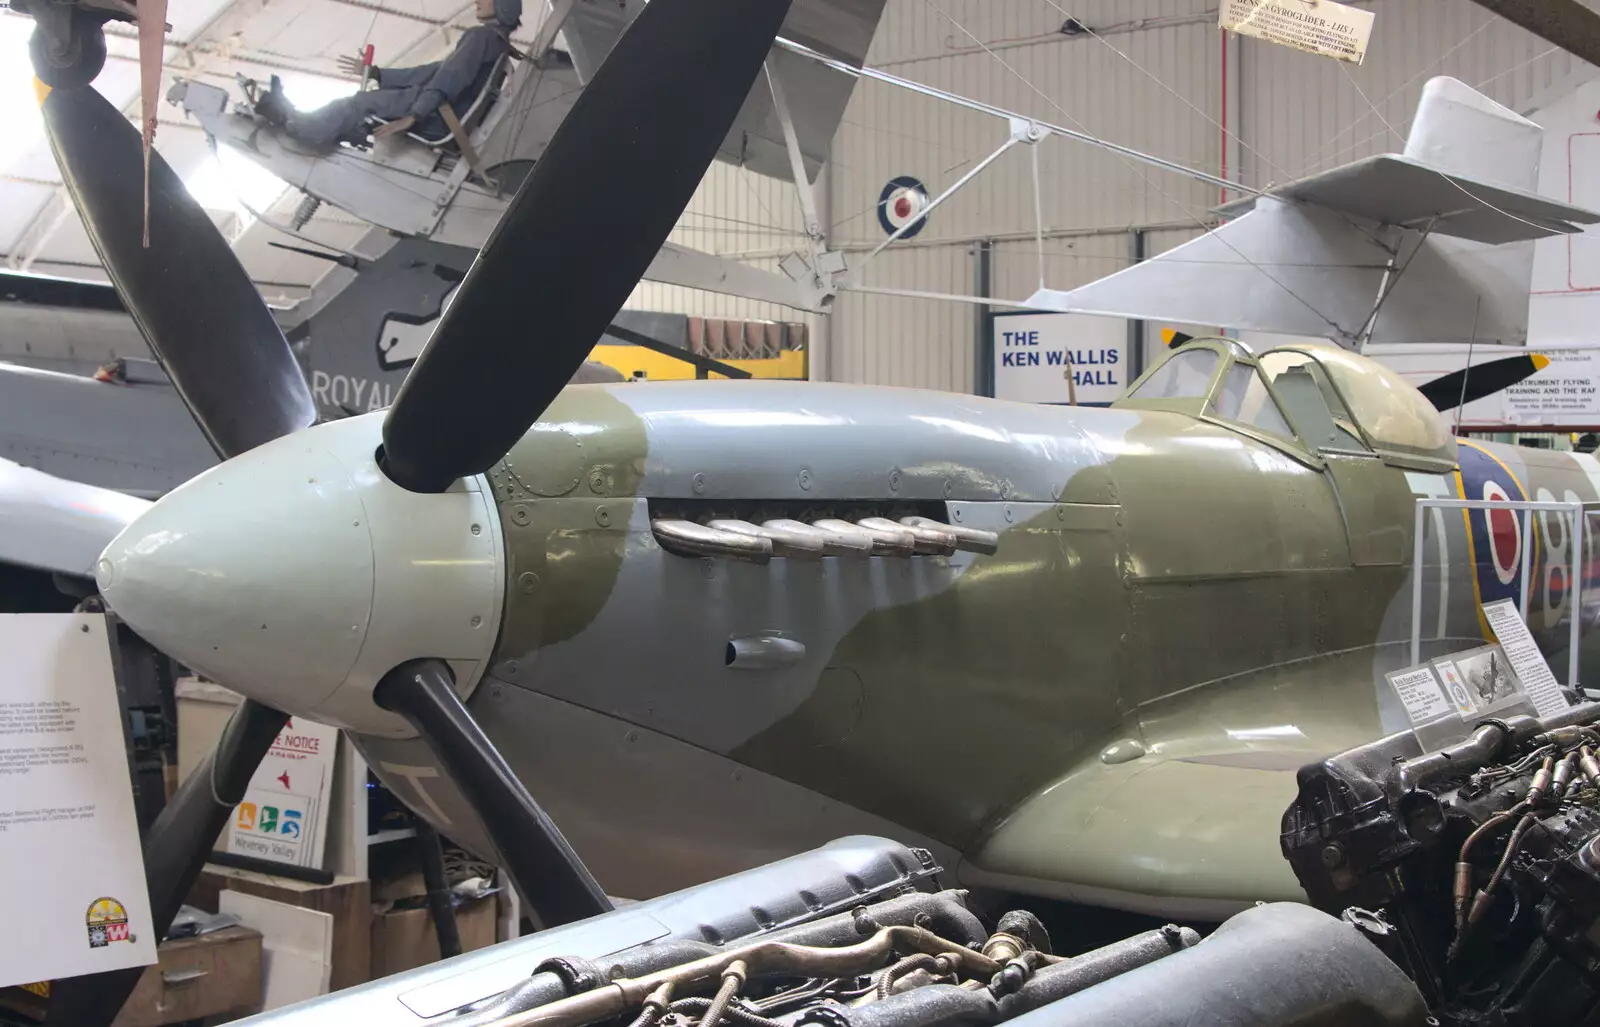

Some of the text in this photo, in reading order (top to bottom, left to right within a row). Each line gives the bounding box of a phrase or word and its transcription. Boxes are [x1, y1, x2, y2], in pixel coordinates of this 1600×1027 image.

[1271, 5, 1325, 27] GYROGLIDER
[1002, 331, 1039, 347] THE
[1002, 349, 1119, 367] KEN WALLIS
[1563, 378, 1591, 386] FLYING
[1505, 387, 1541, 395] TRAINING
[1544, 387, 1560, 395] AND
[285, 734, 320, 751] NOTICE
[234, 835, 296, 861] Waveney Valley
